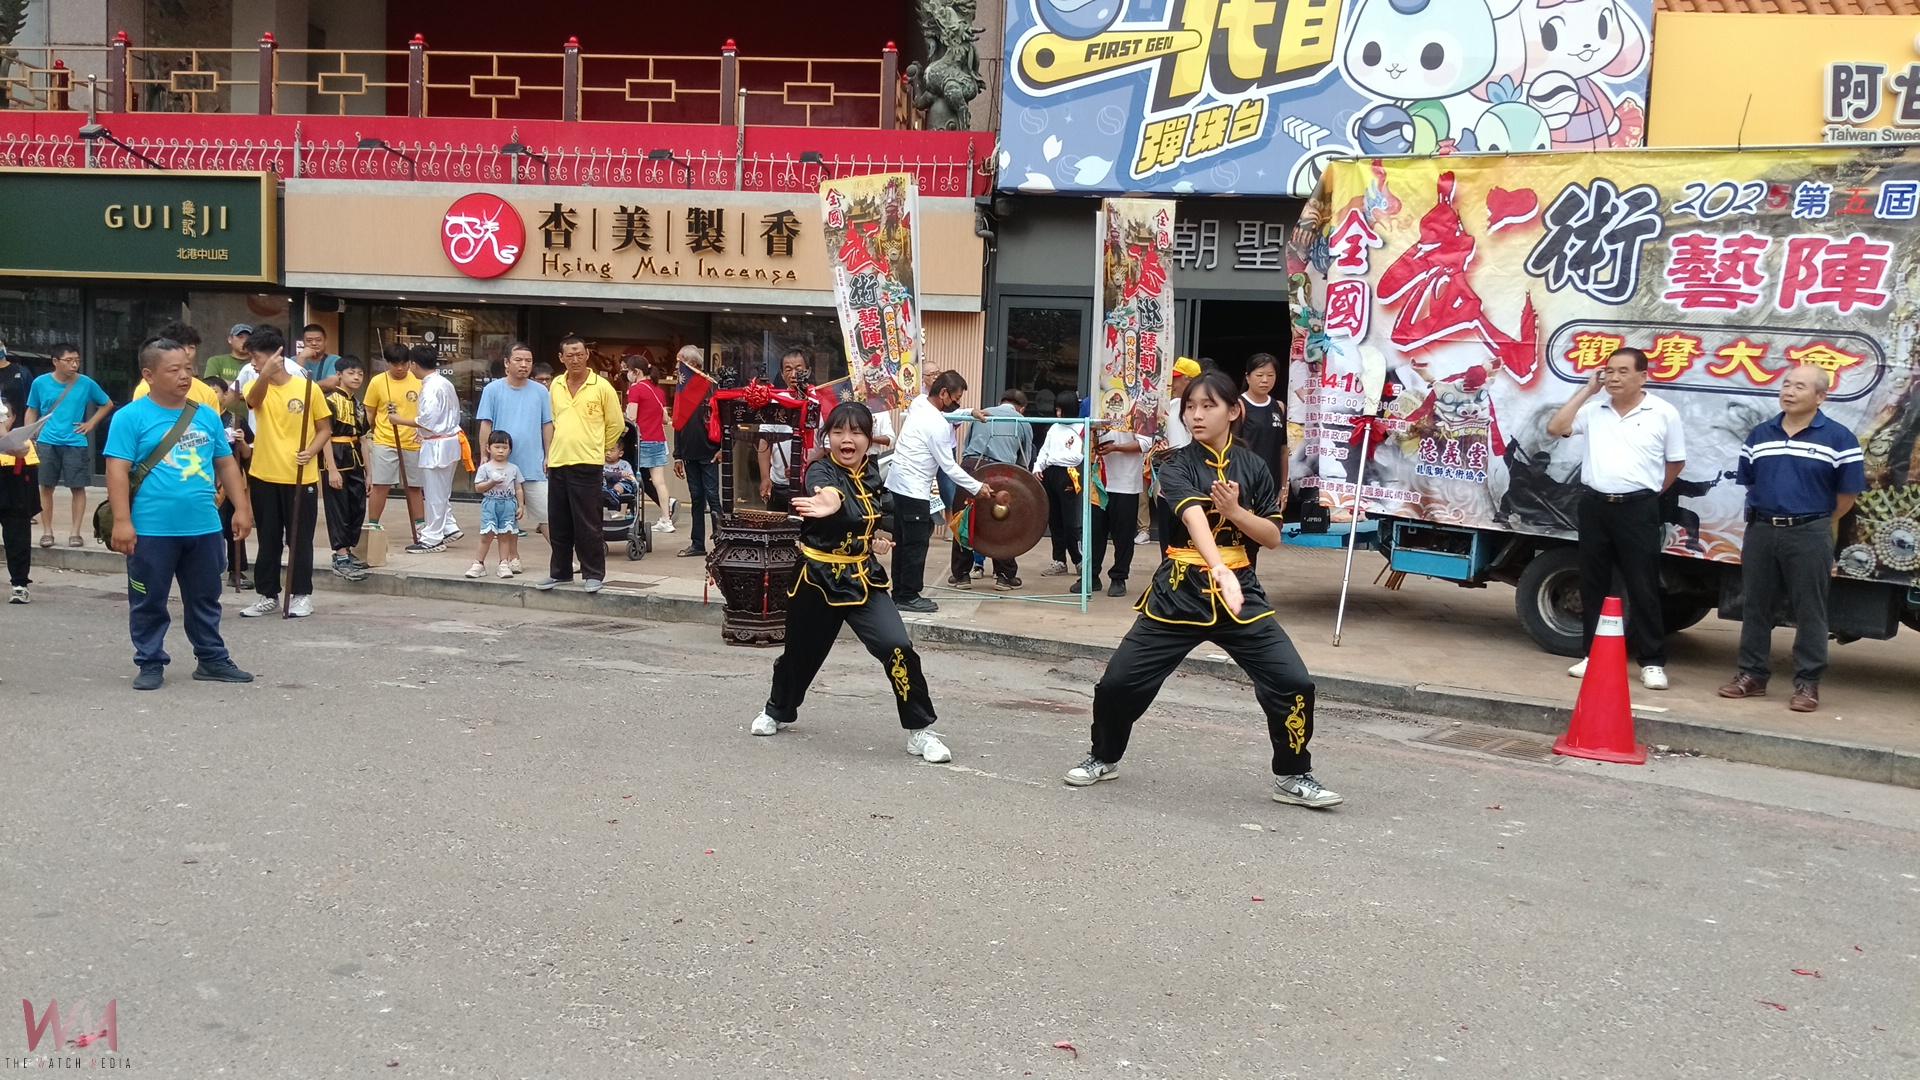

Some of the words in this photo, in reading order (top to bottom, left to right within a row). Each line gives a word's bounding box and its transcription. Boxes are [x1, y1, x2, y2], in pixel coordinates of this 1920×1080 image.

[1084, 38, 1142, 62] FIRST
[1145, 36, 1174, 53] GEN
[1135, 98, 1264, 175] 彈珠台
[1829, 127, 1877, 141] Taiwan
[824, 187, 846, 228] 全國
[176, 248, 228, 260] 北港中山店
[1173, 218, 1284, 269] 朝聖
[542, 253, 613, 279] Hsing
[632, 256, 679, 279] Mei
[699, 258, 797, 285] Incense
[1326, 209, 1383, 344] 全國
[1664, 233, 1892, 312] 藝陣
[1419, 438, 1488, 468] 德義堂
